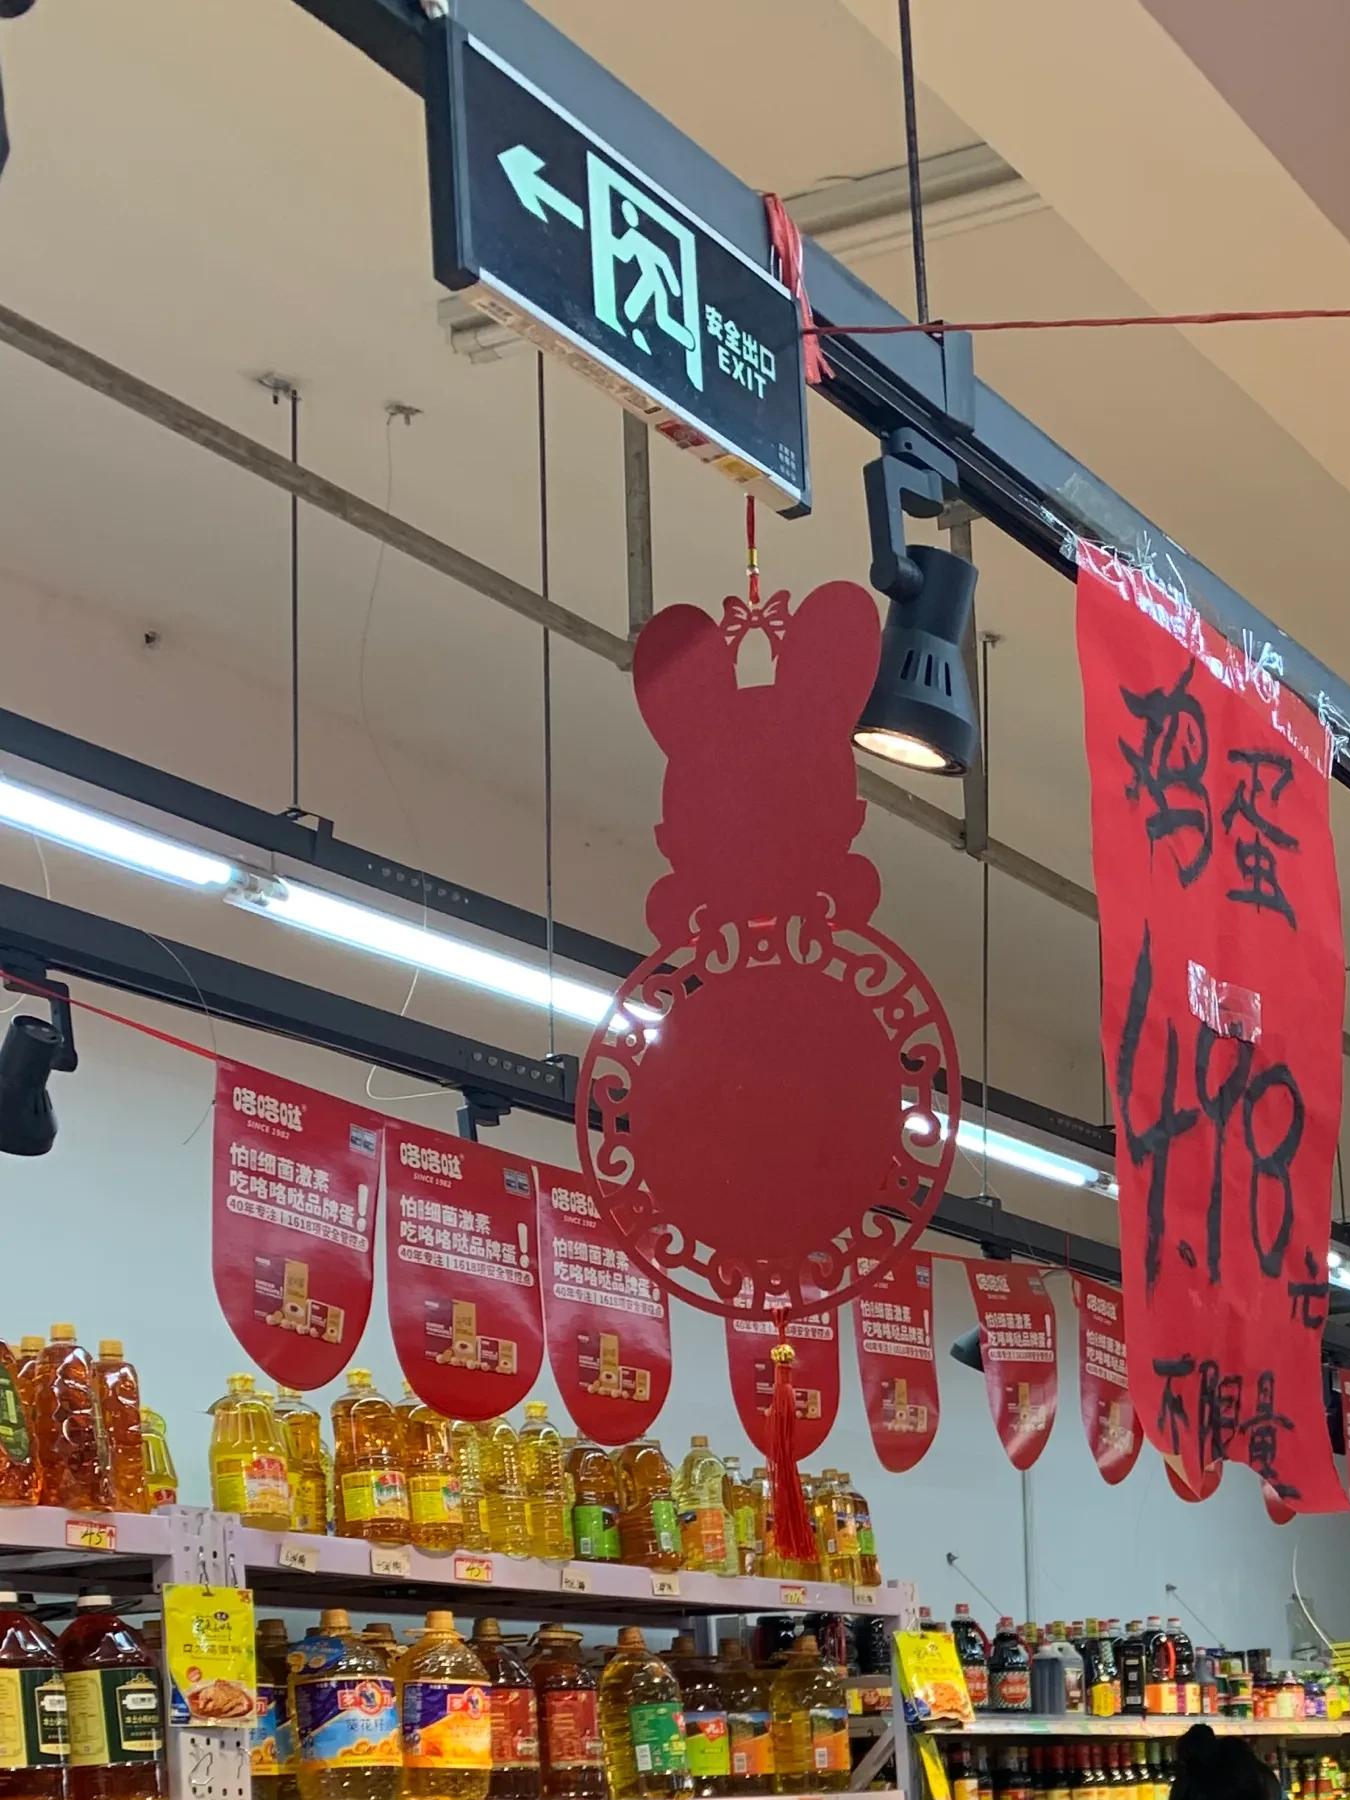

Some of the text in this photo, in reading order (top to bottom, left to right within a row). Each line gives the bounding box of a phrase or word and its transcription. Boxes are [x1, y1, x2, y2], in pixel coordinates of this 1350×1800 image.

[705, 304, 777, 382] 安全出口
[718, 350, 769, 400] EXIT
[247, 1120, 290, 1139] SINCE 1982
[230, 1142, 331, 1193] 怕细菌激素
[400, 1194, 491, 1235] 怕细菌激素
